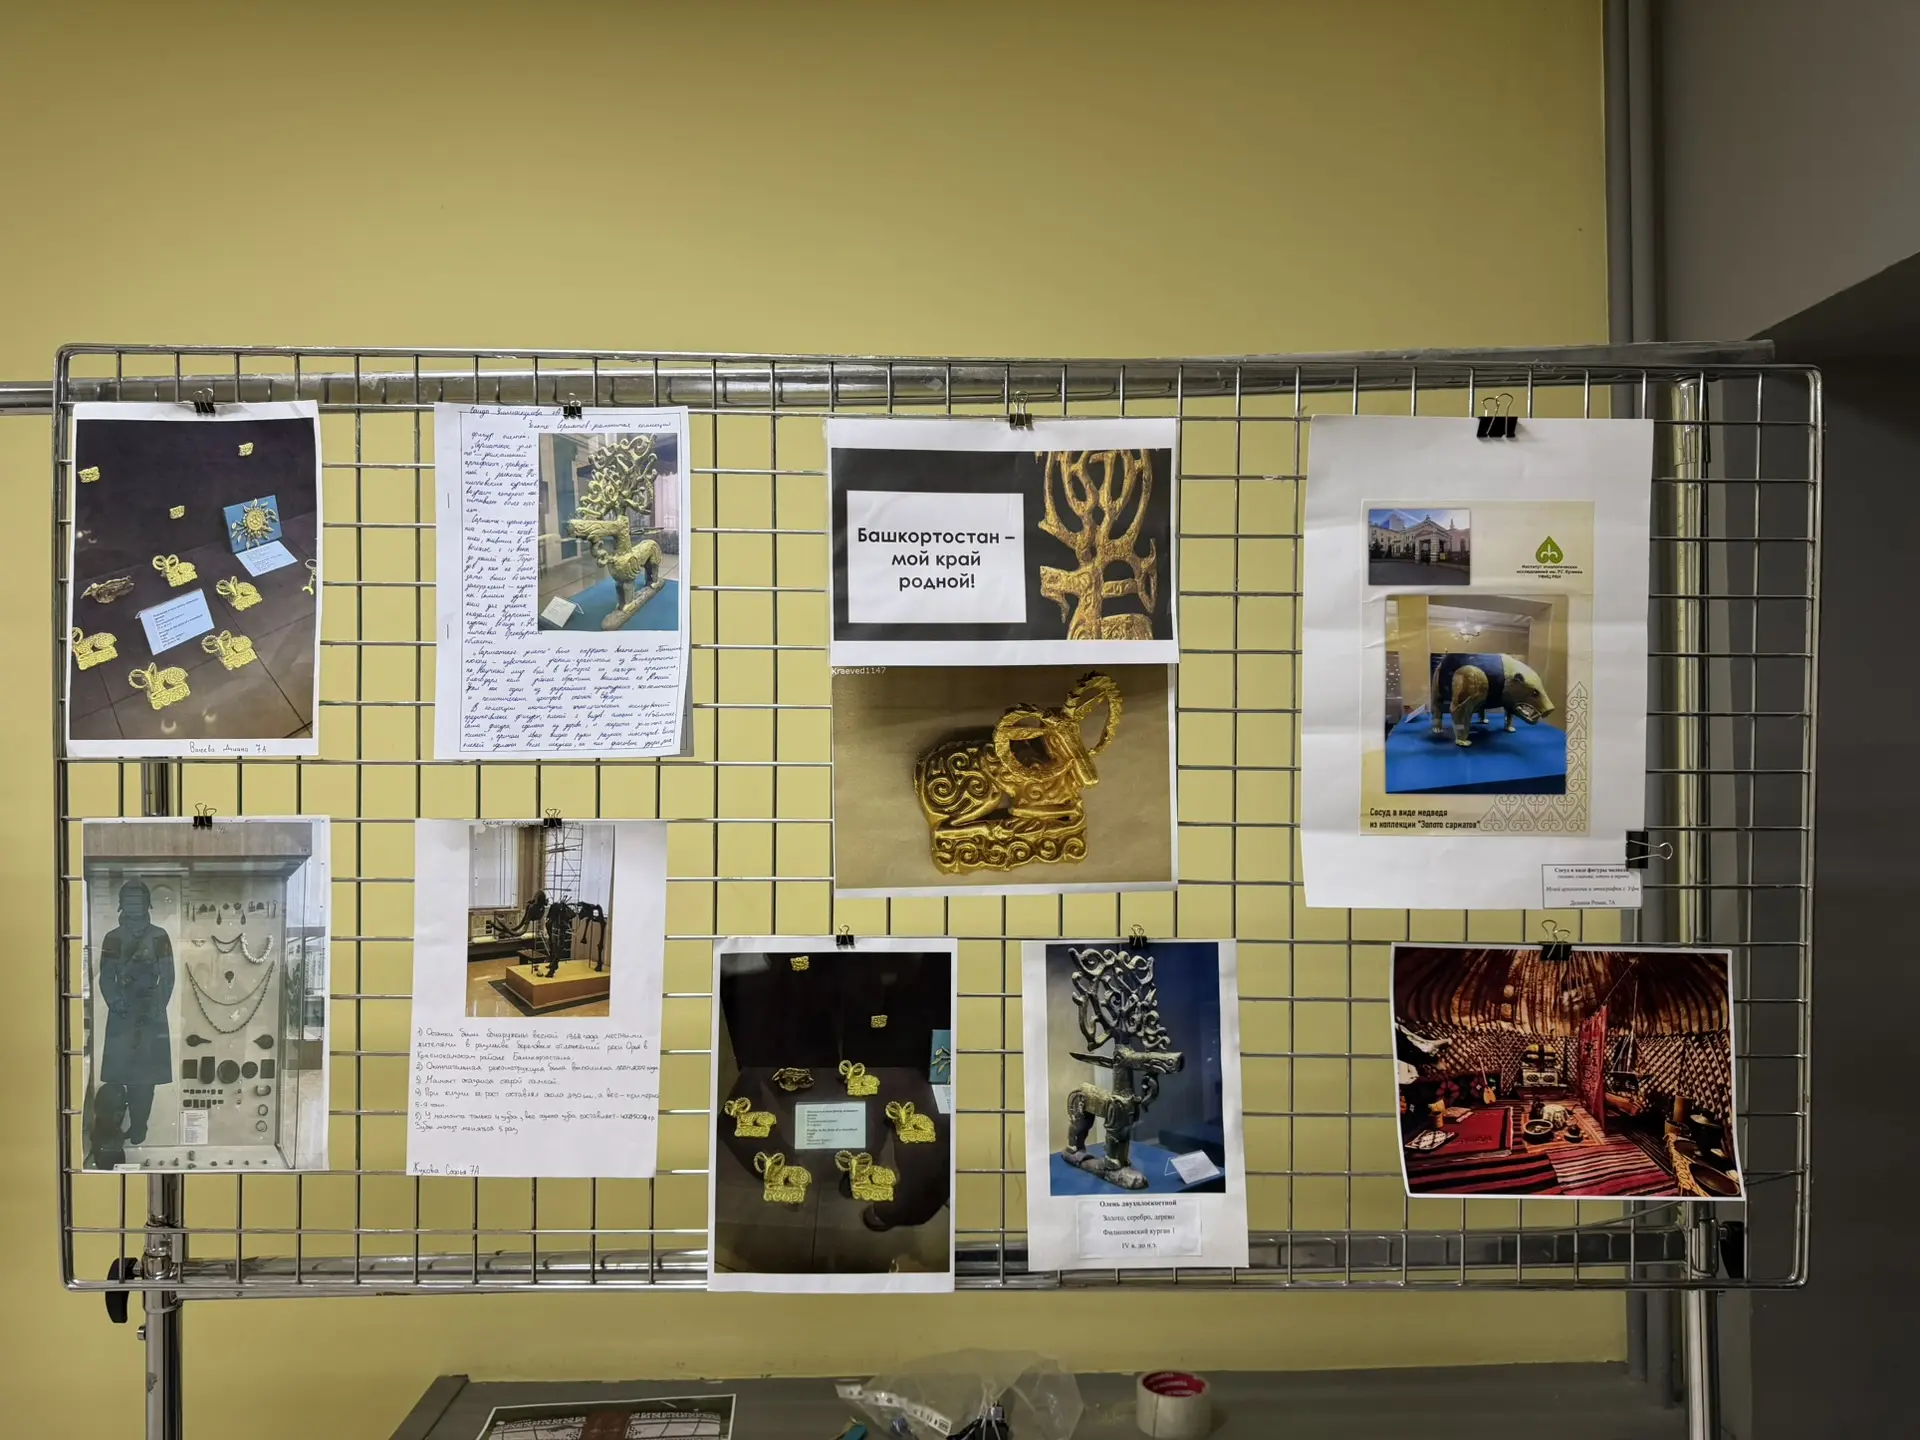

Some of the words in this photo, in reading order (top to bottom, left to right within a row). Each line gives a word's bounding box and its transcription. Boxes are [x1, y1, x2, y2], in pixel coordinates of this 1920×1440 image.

[857, 527, 1000, 547] Башкортостан
[891, 551, 931, 567] мой
[936, 551, 981, 571] край
[899, 573, 976, 592] родной!
[832, 666, 886, 675] Kraeved1147
[1369, 808, 1391, 818] Сосуд
[1399, 809, 1416, 817] виде
[1417, 809, 1448, 817] медведя
[1379, 821, 1416, 829] коллекции
[1418, 820, 1443, 828] "Золото
[1445, 820, 1480, 830] сарматов"
[412, 1161, 439, 1175] Жукова
